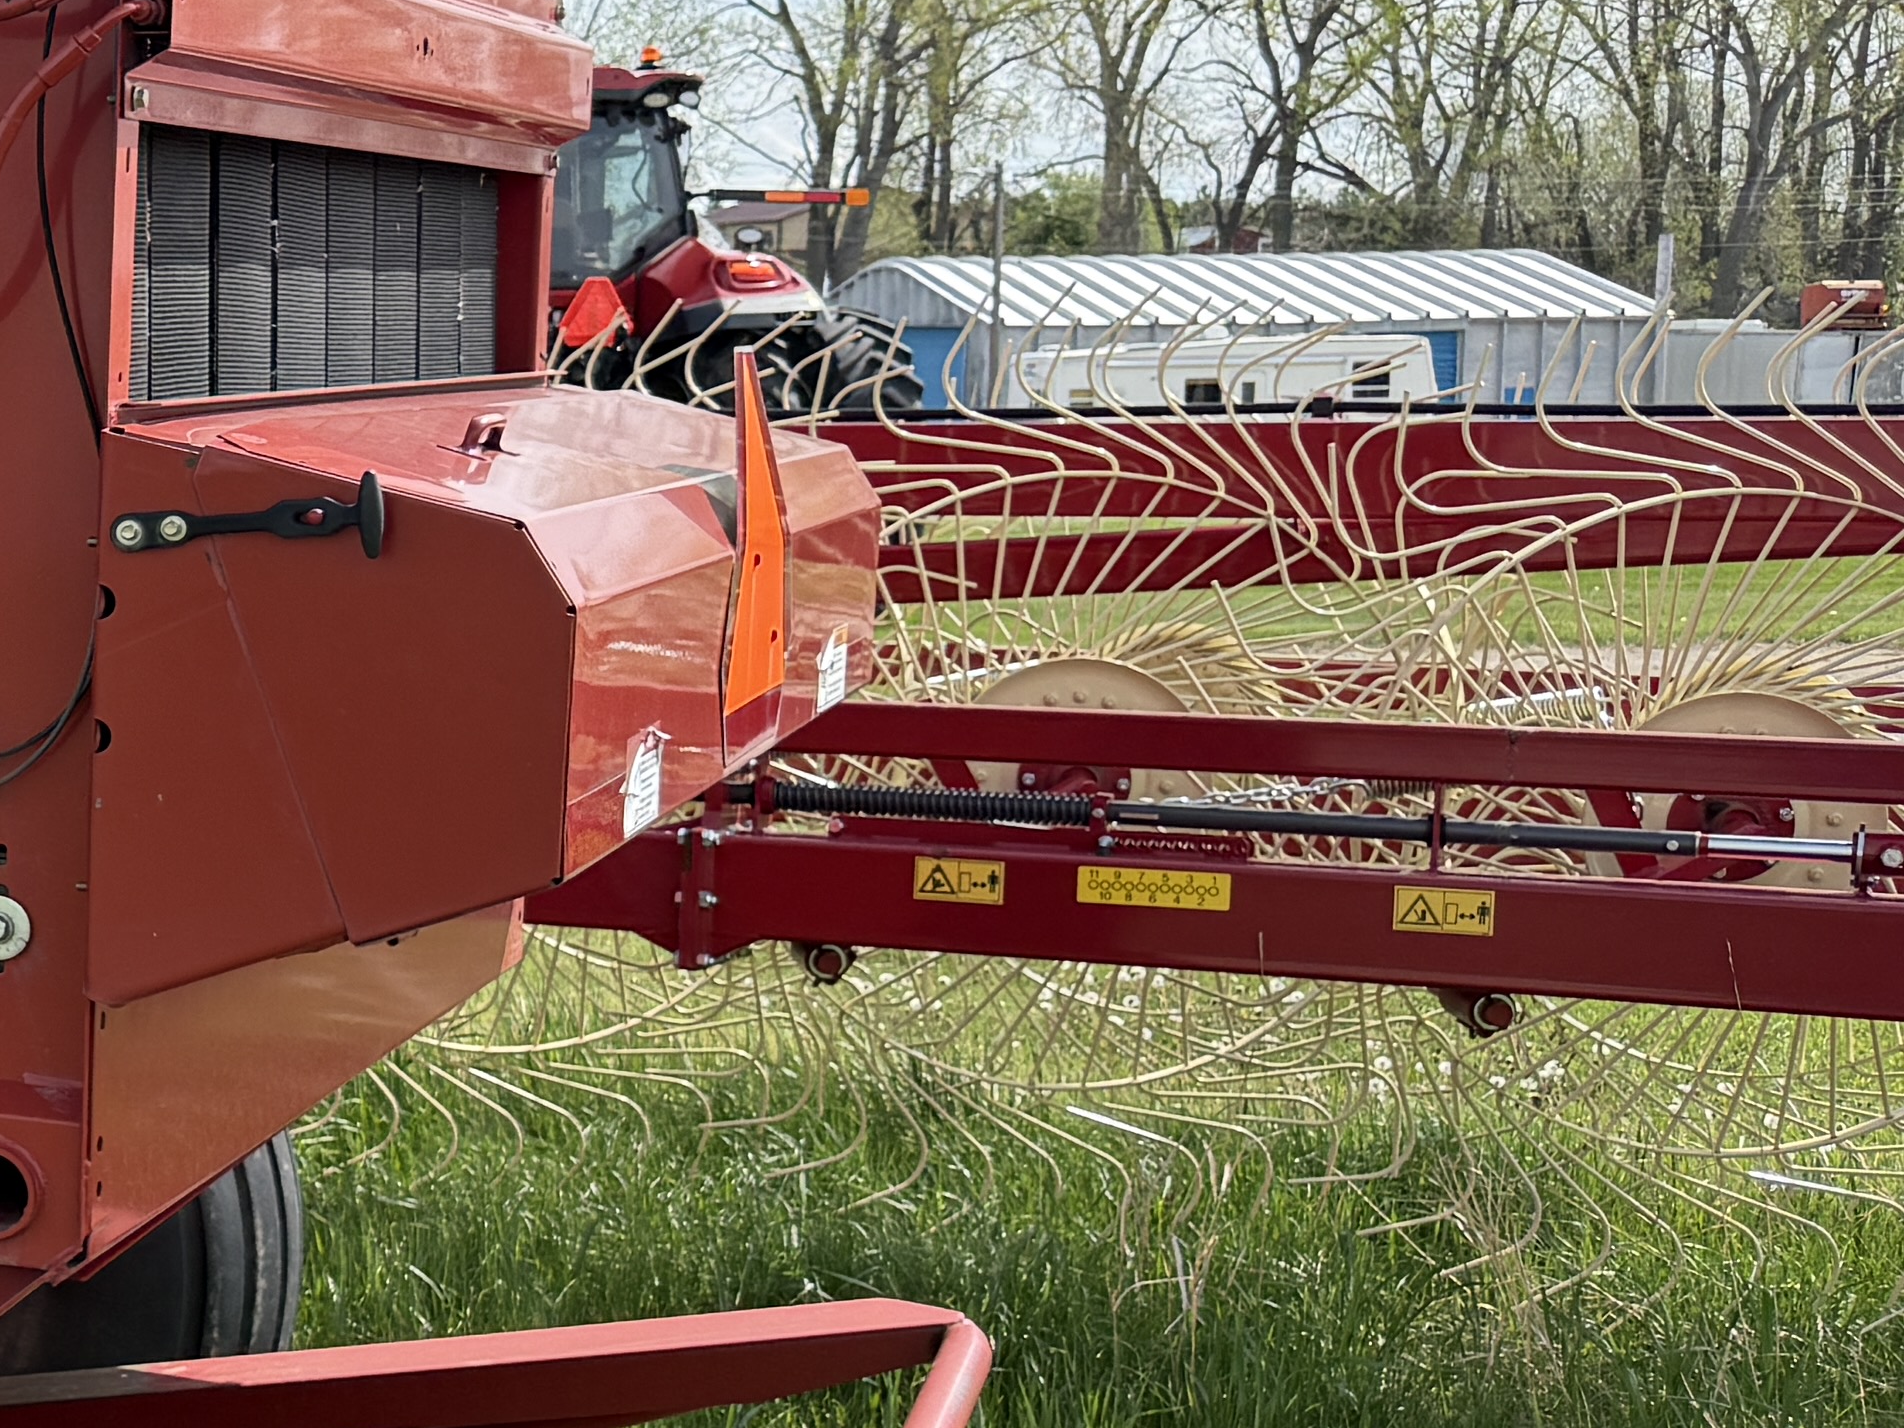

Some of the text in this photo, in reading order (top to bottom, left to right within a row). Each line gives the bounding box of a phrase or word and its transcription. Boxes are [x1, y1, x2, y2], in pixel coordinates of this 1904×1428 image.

[1090, 869, 1099, 879] 11
[1162, 873, 1170, 883] 5
[1100, 891, 1112, 901] 10
[1173, 894, 1180, 904] 4
[1197, 896, 1205, 906] 2
